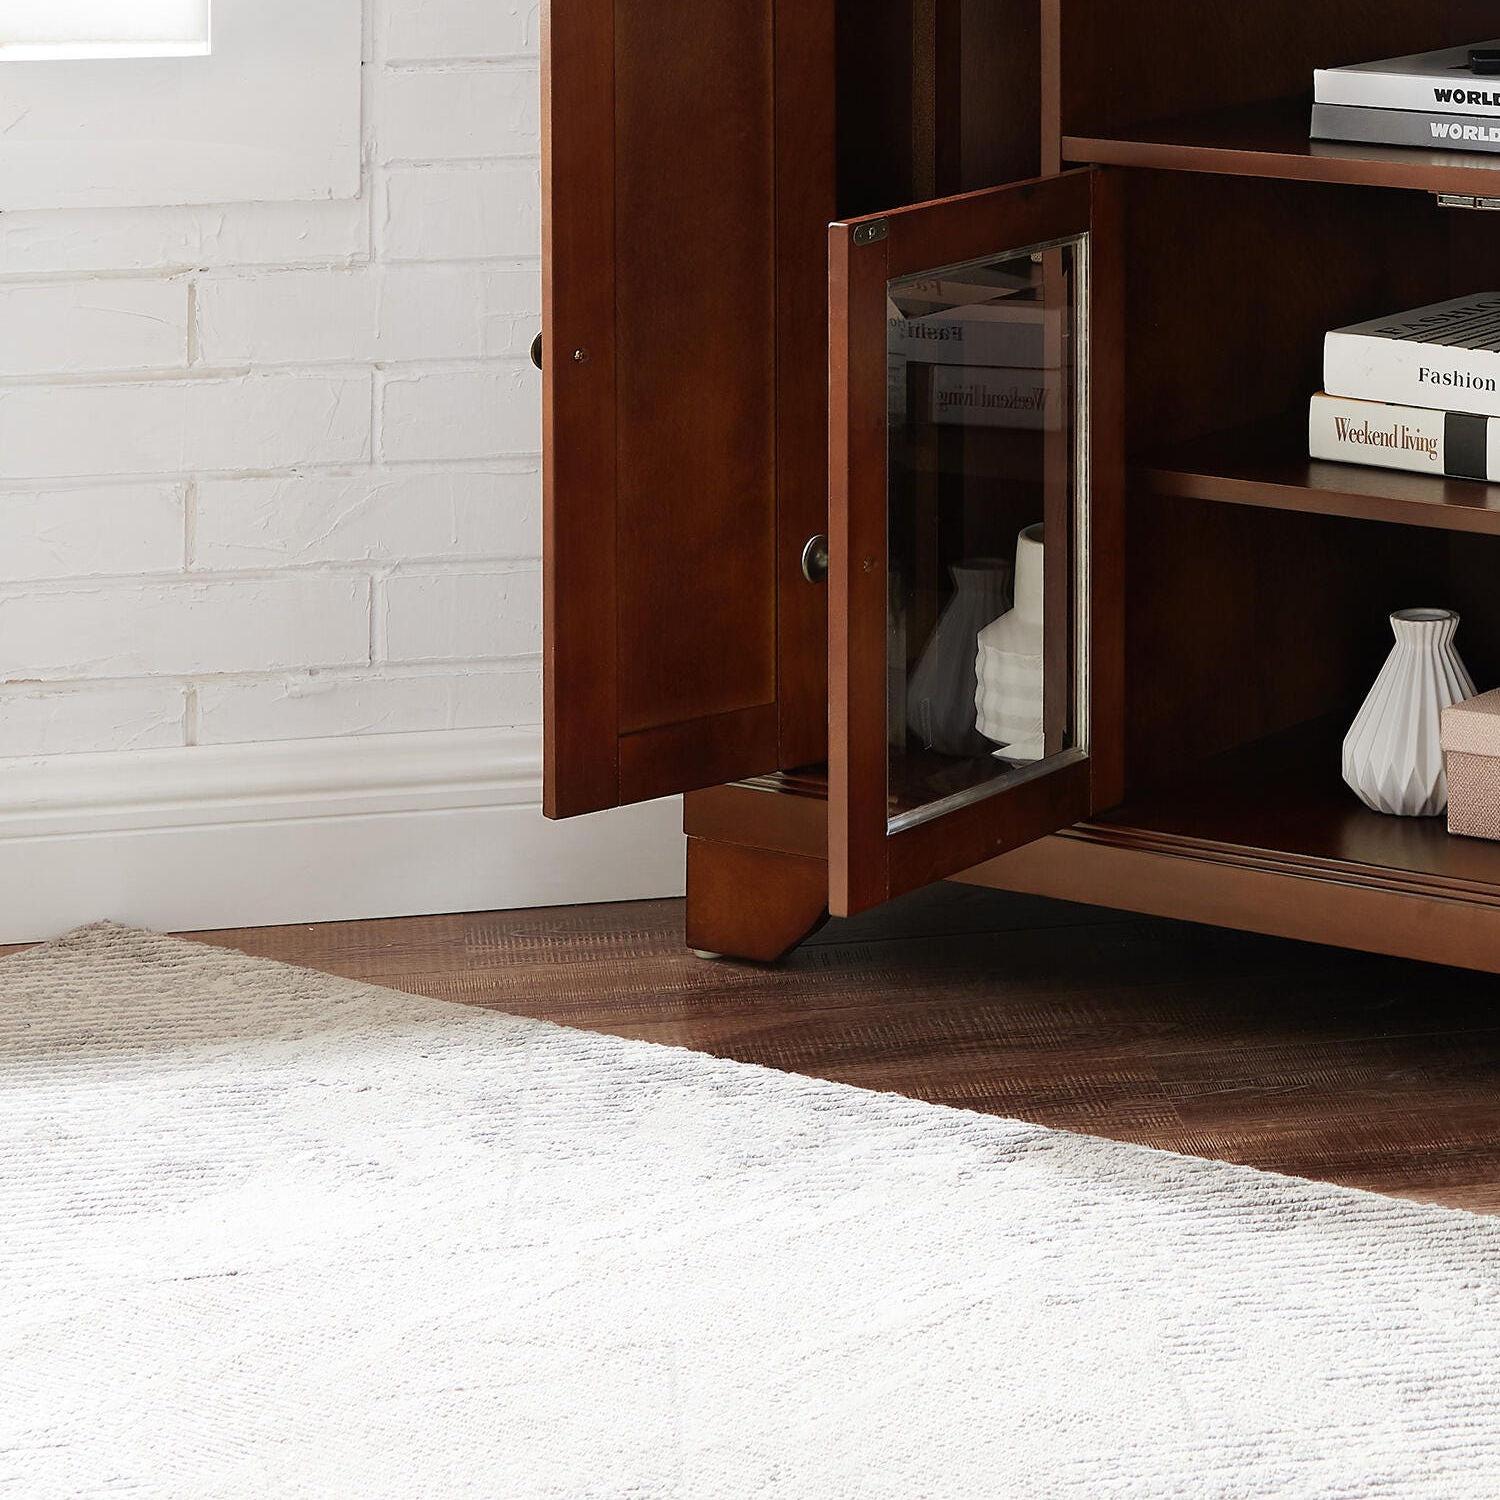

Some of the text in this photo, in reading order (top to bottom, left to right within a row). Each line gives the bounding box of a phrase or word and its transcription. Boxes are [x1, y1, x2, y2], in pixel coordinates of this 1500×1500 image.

[1418, 367, 1496, 392] Fashion
[1334, 416, 1438, 461] Weekend living
